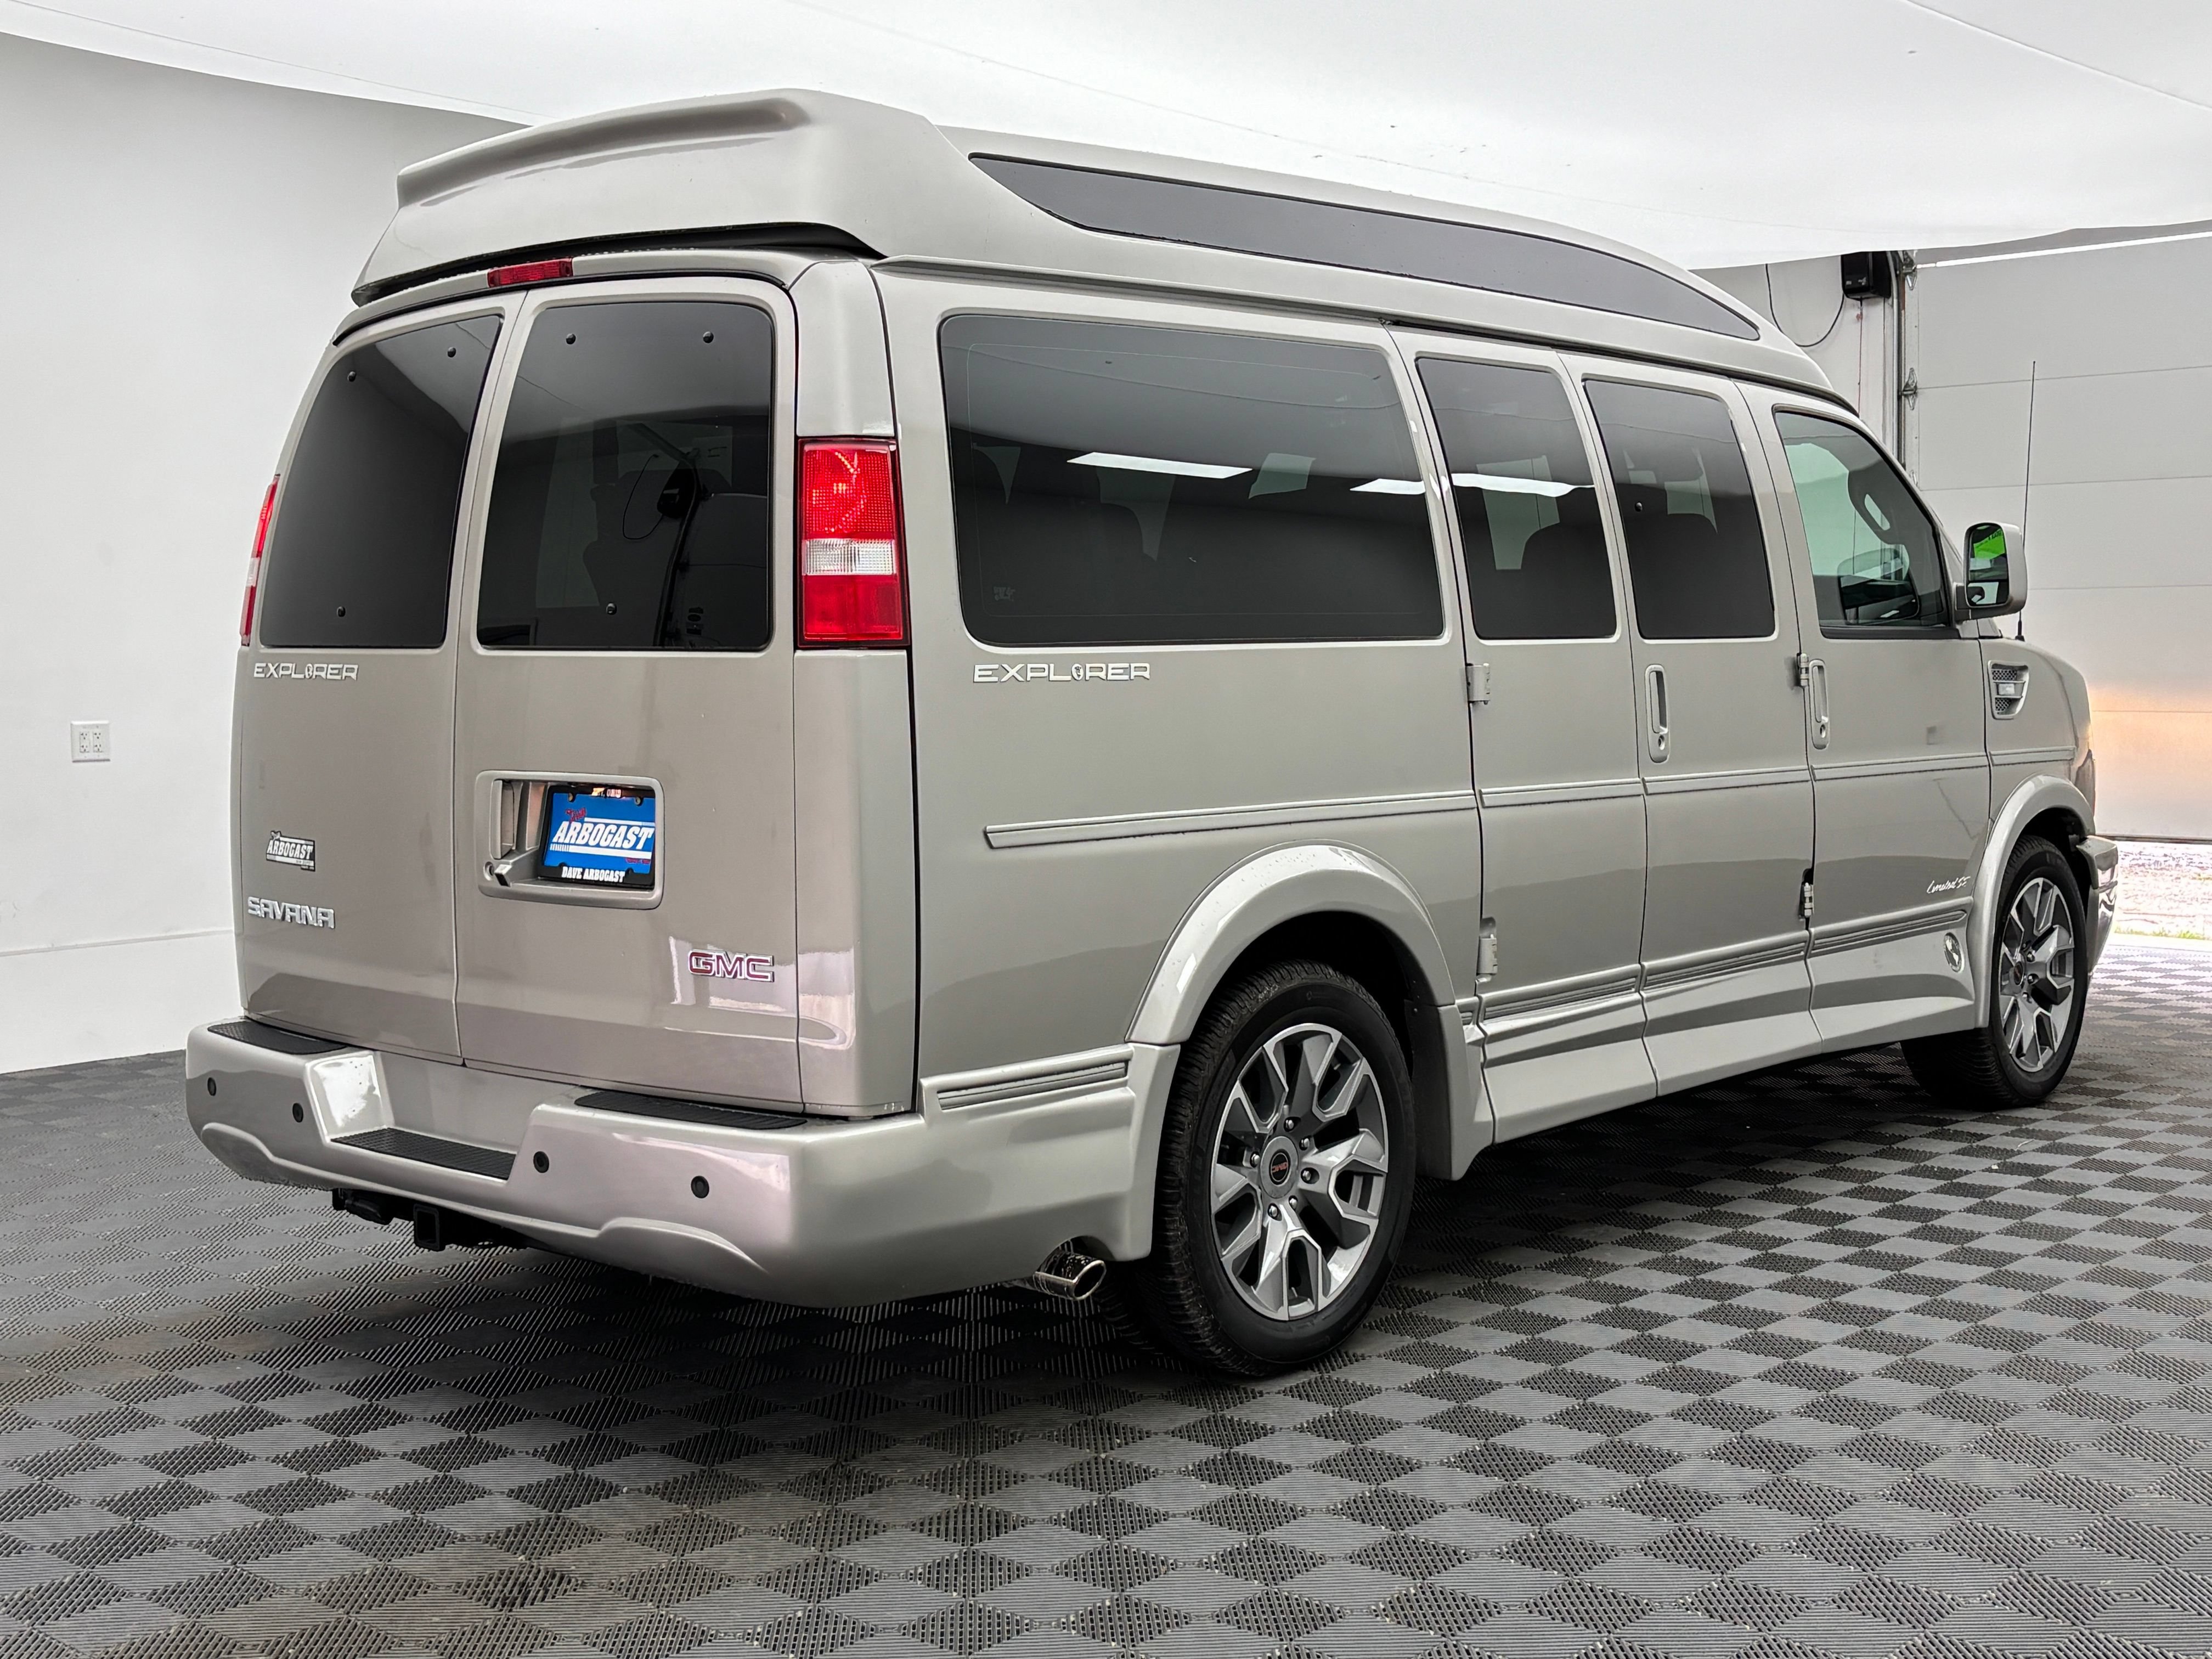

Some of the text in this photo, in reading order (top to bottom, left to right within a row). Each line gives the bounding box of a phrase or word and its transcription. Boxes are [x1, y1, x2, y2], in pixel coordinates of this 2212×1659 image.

[254, 663, 359, 681] EXPLORER
[973, 663, 1150, 682] EXPLORER
[552, 821, 655, 850] ARBOGAST
[267, 839, 314, 860] ARBOGAST
[561, 866, 625, 883] DAVE ARBOGAST
[247, 896, 335, 929] SAVANA
[689, 949, 774, 983] GMC
